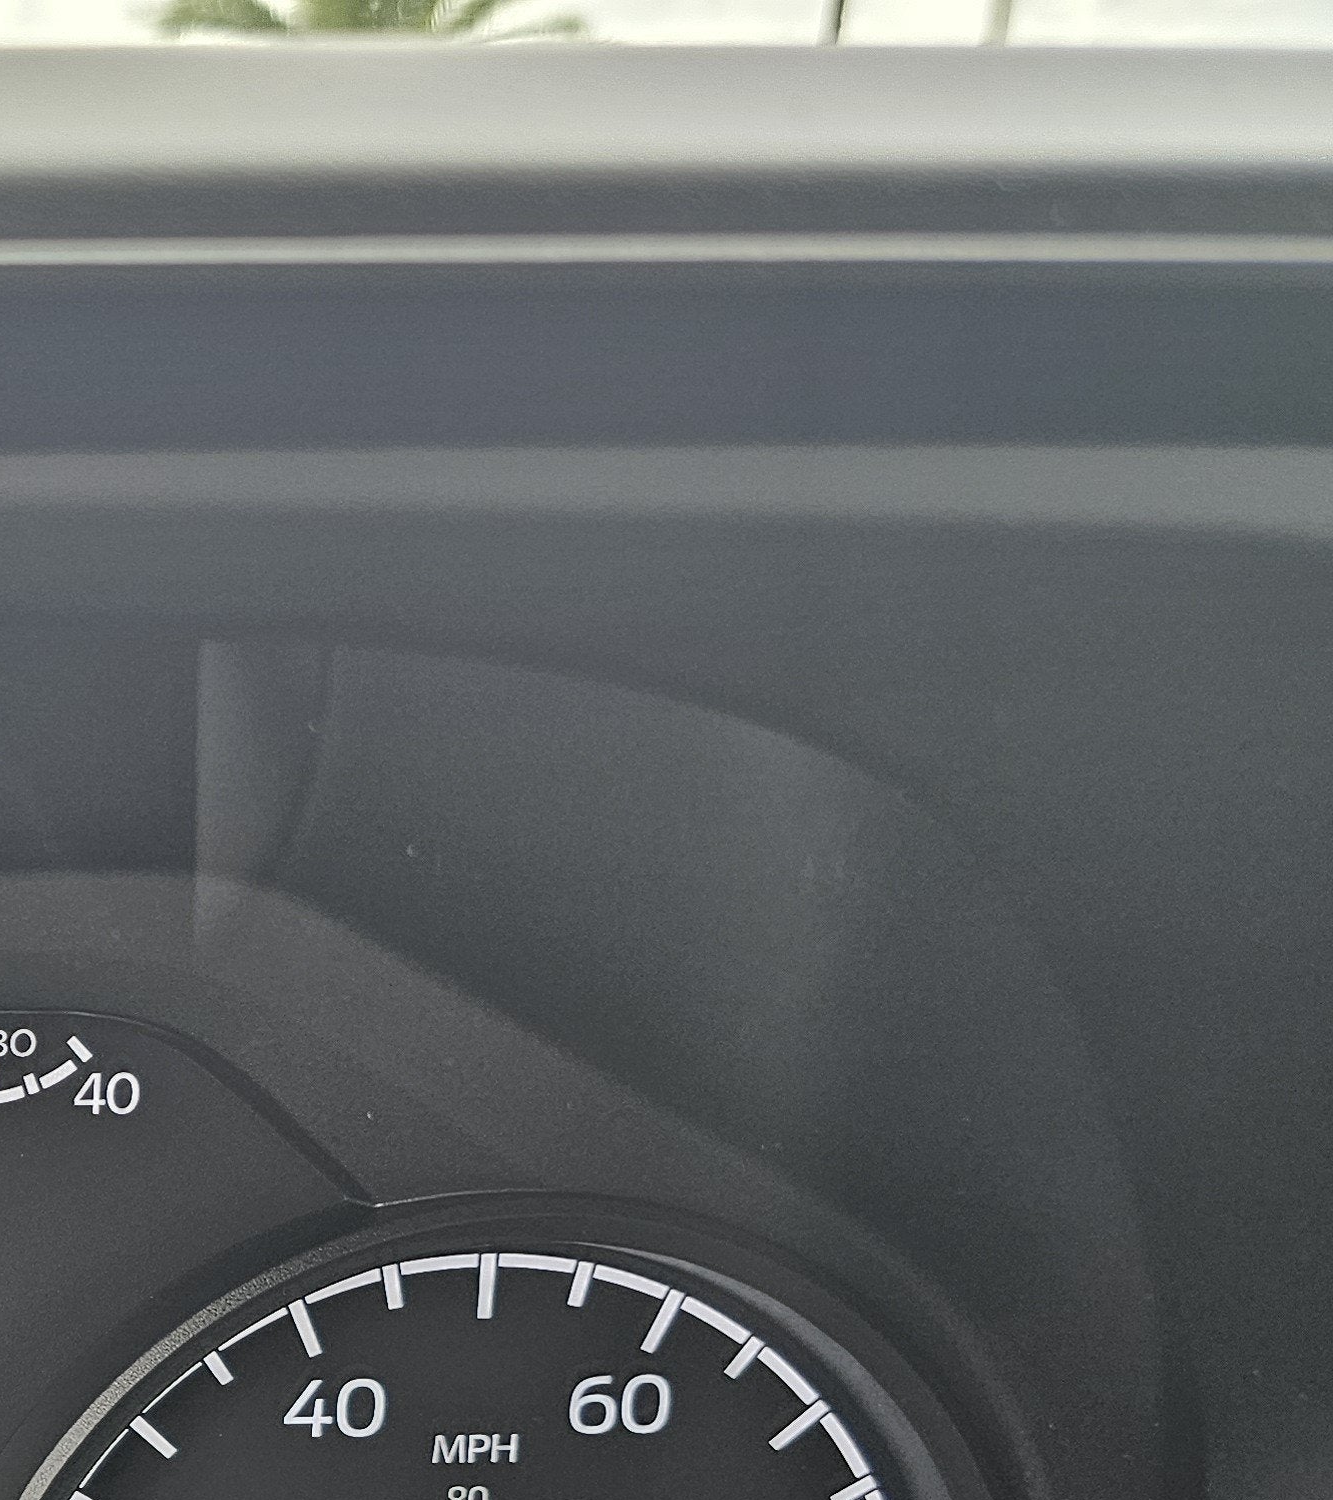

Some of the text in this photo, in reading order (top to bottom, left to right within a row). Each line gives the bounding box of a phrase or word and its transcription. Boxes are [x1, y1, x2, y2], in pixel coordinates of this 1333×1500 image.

[72, 1071, 141, 1116] 40
[283, 1378, 386, 1438] 40
[569, 1373, 671, 1435] 60
[431, 1433, 519, 1464] MPH
